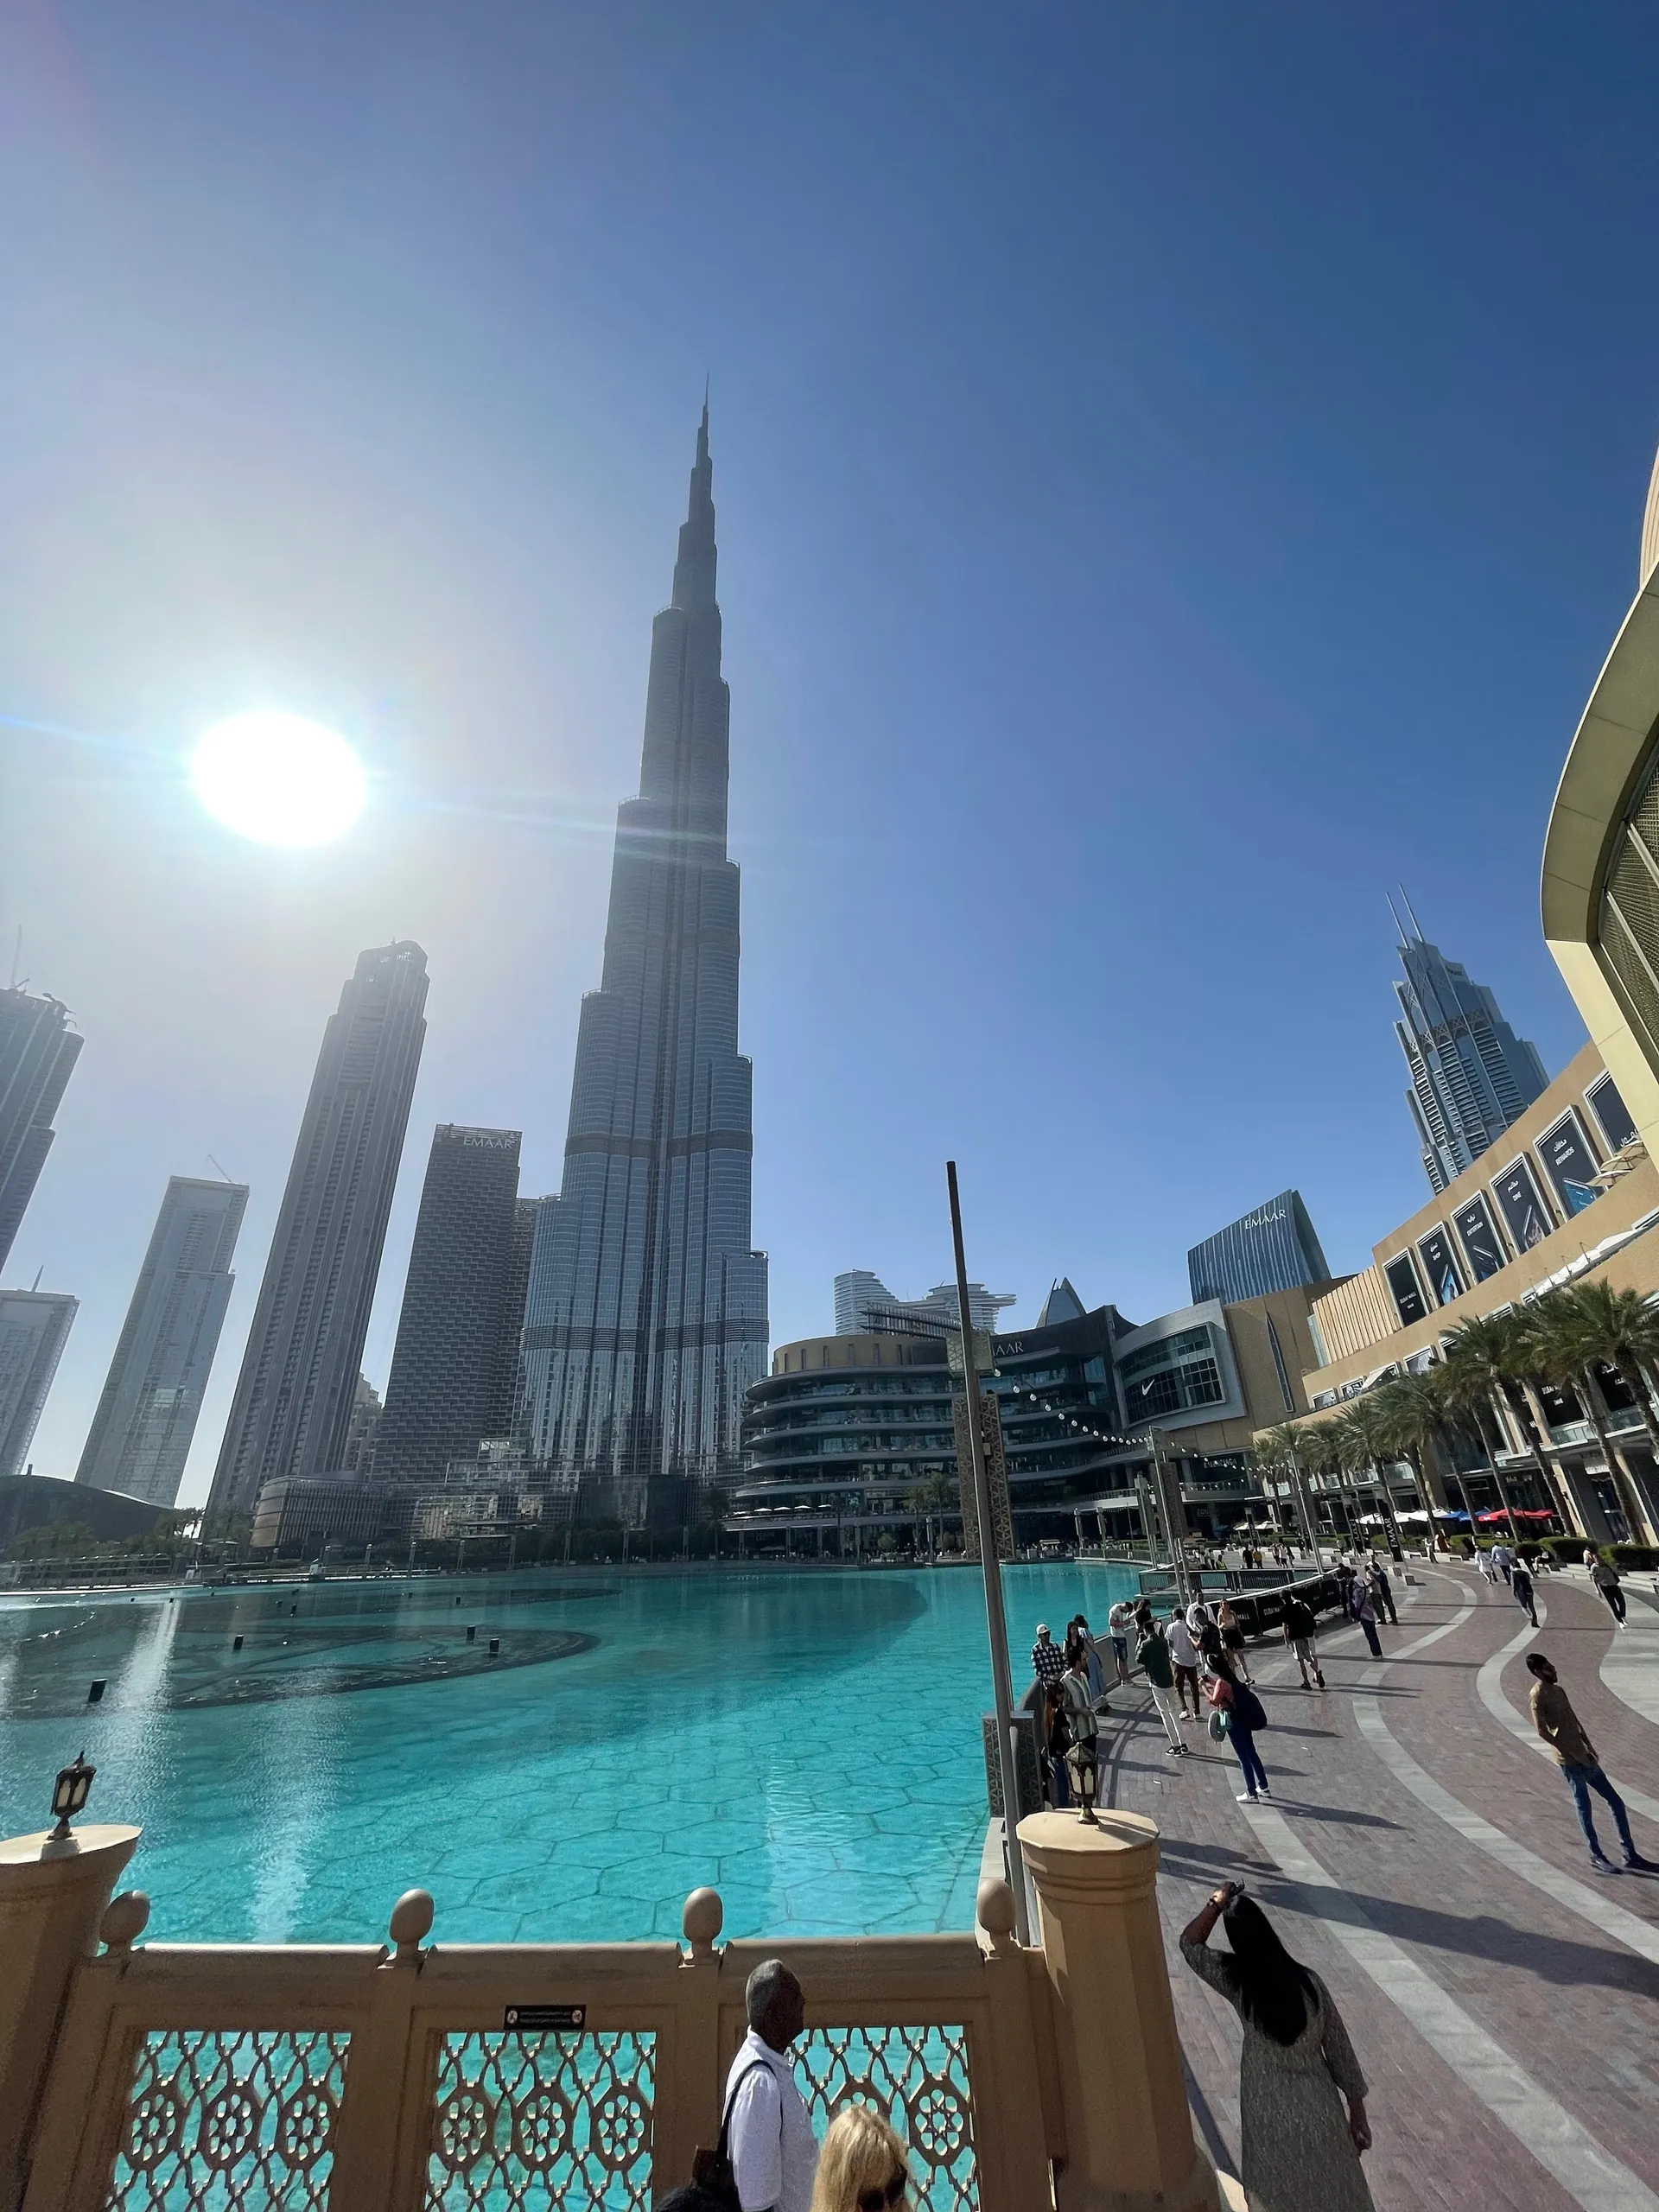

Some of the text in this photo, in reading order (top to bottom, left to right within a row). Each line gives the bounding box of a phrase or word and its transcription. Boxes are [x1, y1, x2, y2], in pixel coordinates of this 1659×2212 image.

[463, 1136, 513, 1149] EMAAR
[1245, 1209, 1287, 1230] EMAAR
[1384, 1517, 1398, 1548] EMAAR
